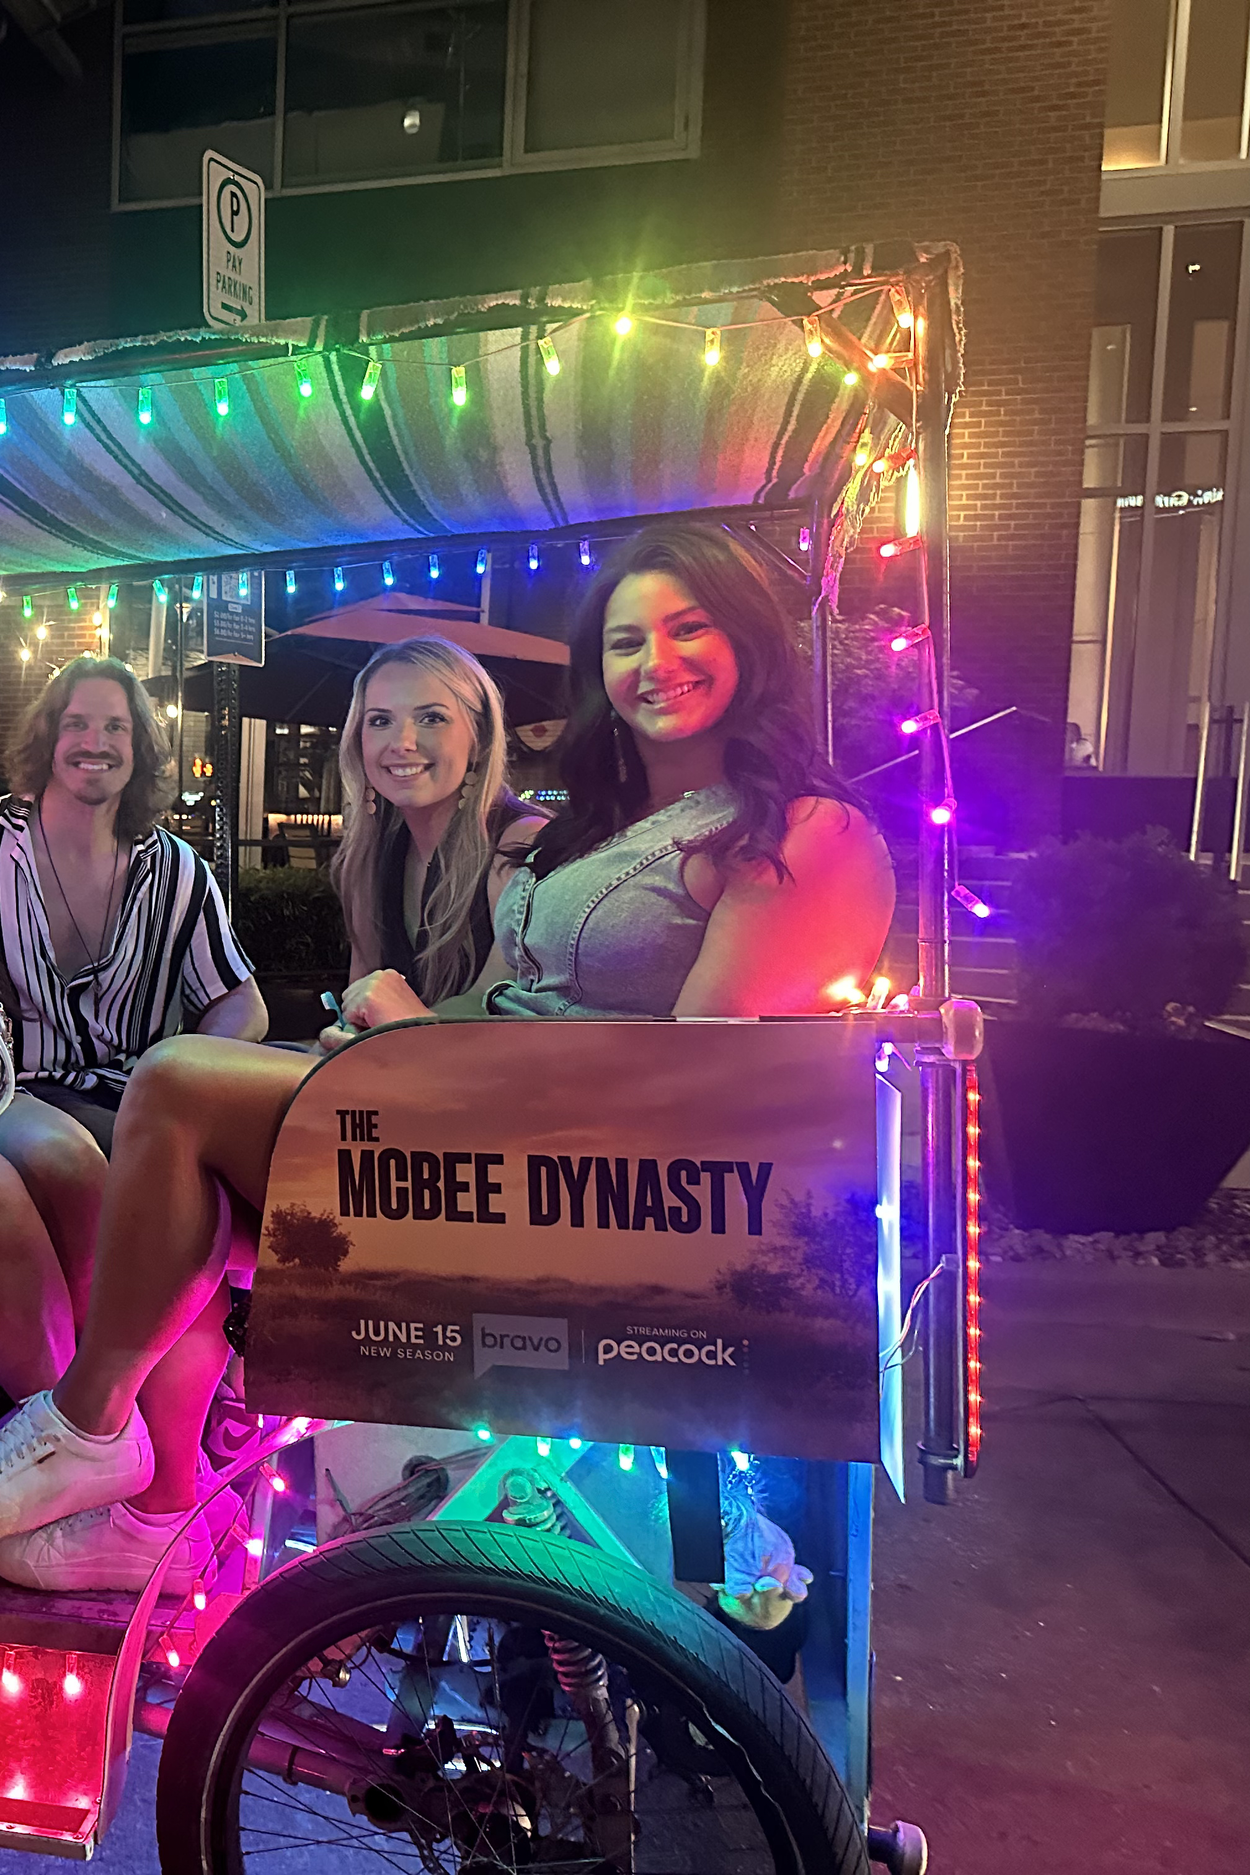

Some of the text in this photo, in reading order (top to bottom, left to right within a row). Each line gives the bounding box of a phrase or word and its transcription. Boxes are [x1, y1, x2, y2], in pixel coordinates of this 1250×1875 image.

[230, 190, 240, 233] P
[226, 251, 243, 276] PAY
[216, 272, 253, 306] PARKING
[336, 1109, 380, 1142] THE
[337, 1148, 773, 1236] MCBEE DYNASTY
[351, 1319, 462, 1347] JUNE 15
[481, 1327, 562, 1354] bravo
[626, 1325, 707, 1339] STREAMING ON
[360, 1345, 454, 1362] NEW SEASON
[598, 1338, 737, 1367] peacock
